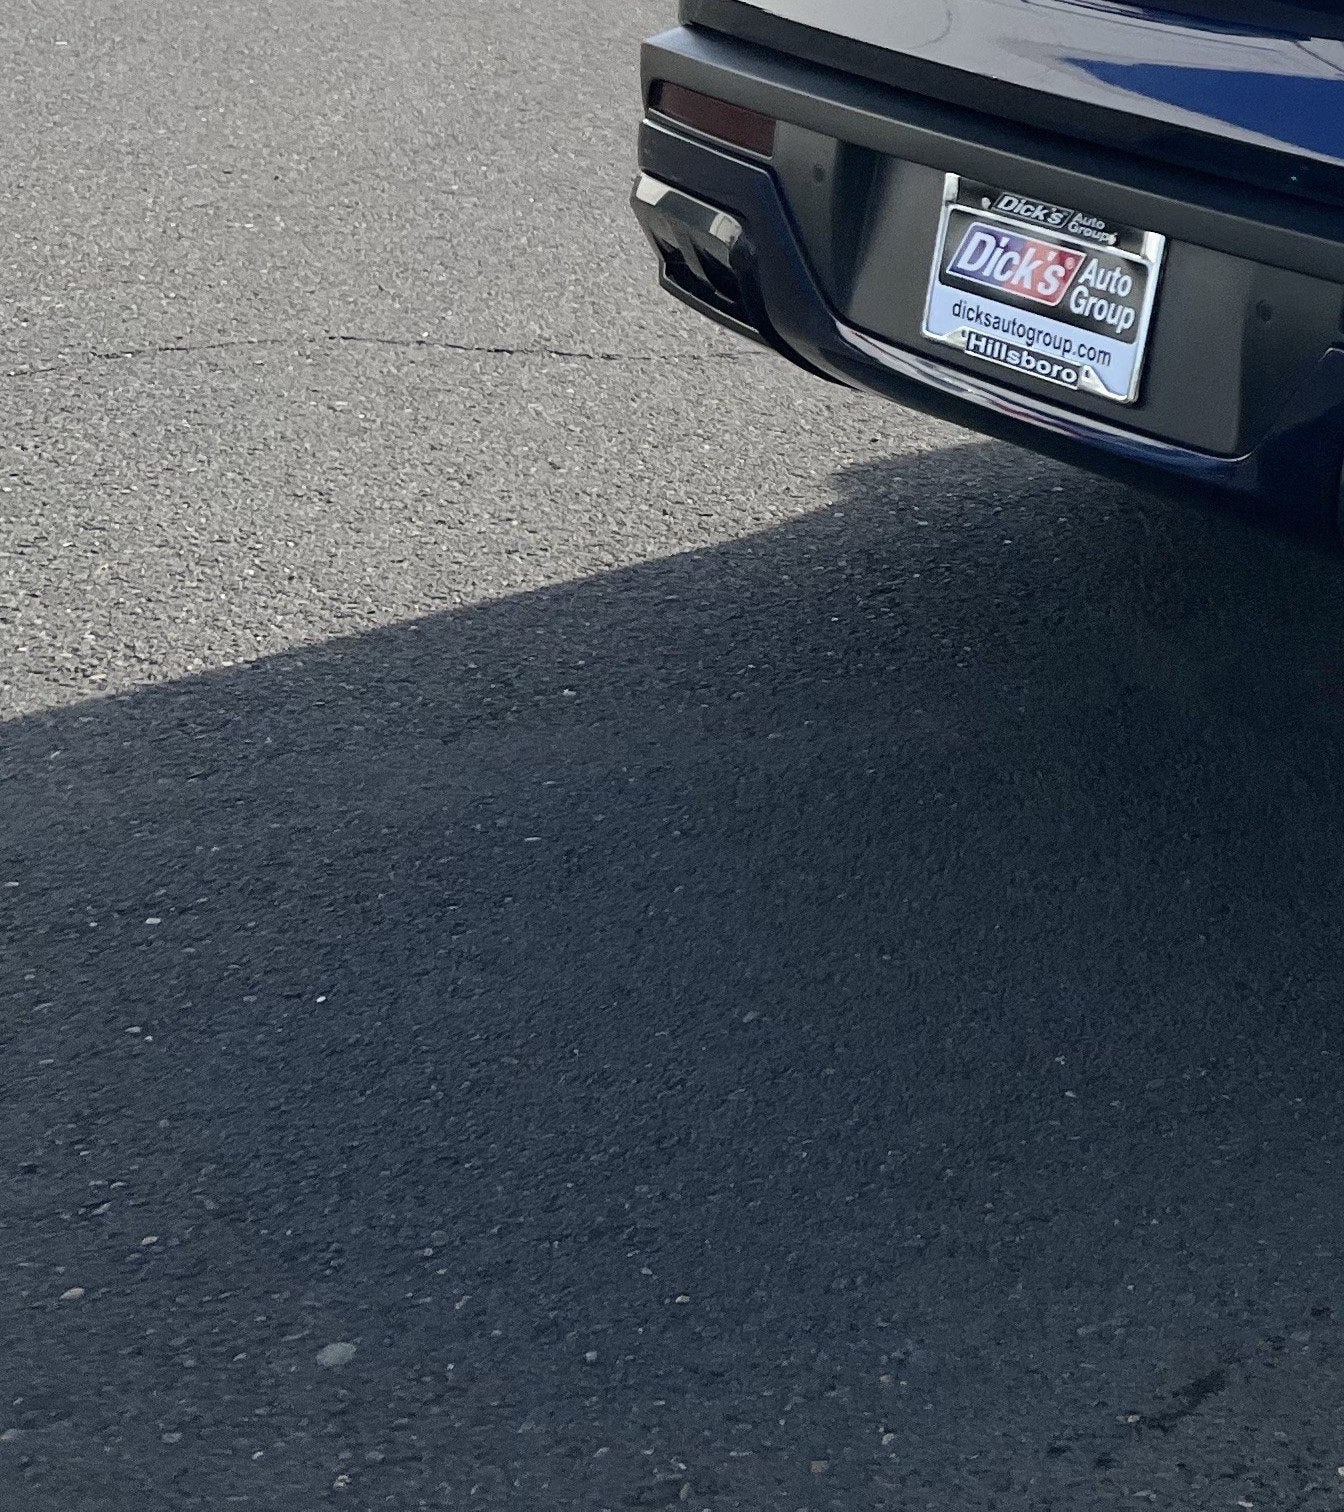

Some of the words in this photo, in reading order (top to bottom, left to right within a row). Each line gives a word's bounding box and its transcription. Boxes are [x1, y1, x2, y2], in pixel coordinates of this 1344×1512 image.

[997, 195, 1064, 225] Dick's
[1072, 212, 1106, 230] Auto
[1067, 221, 1110, 244] Group
[957, 232, 1066, 297] Dick's
[1078, 258, 1133, 298] Auto
[1069, 285, 1136, 334] Group
[951, 299, 1113, 367] dicksautogroup.com
[967, 332, 1079, 384] Hillsboro
